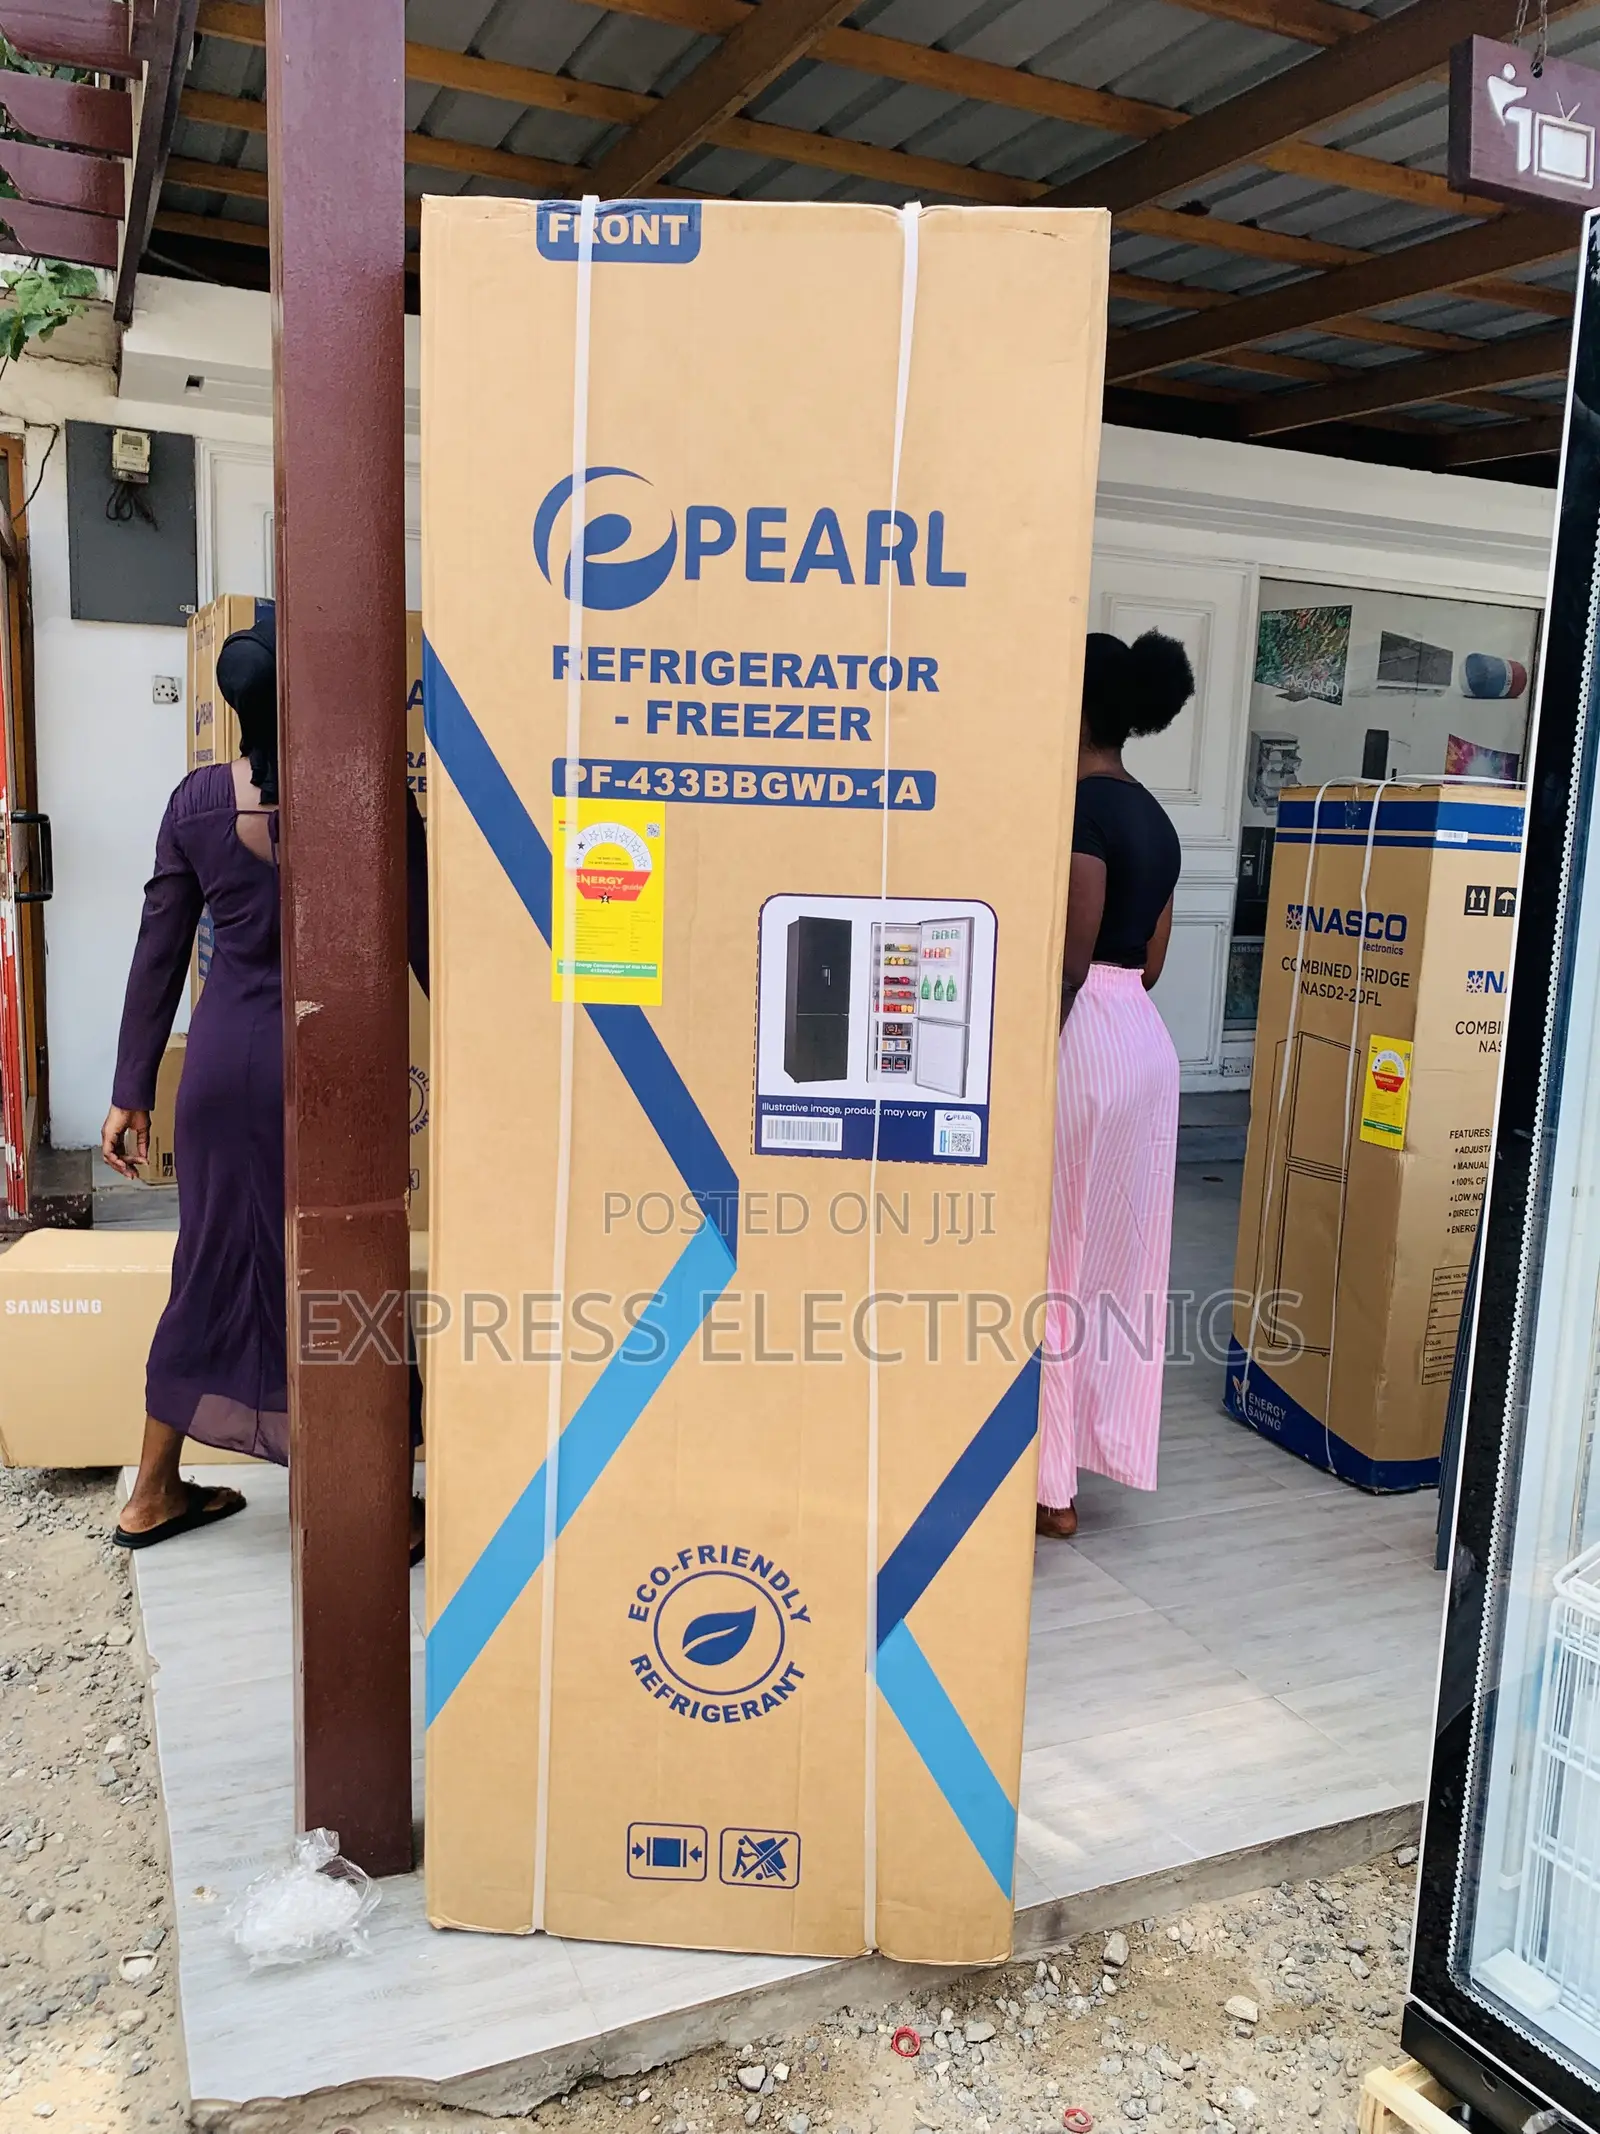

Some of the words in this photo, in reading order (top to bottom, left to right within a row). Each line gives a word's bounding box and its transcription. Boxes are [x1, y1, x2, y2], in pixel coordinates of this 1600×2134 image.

[549, 213, 689, 246] FRONT
[684, 504, 967, 588] PEARL
[552, 644, 940, 692] REFRIGERATOR
[646, 699, 872, 742] FREEZER
[565, 764, 922, 804] PF-433BBGWD-1A
[1304, 905, 1407, 942] NASCO
[1362, 941, 1404, 956] lectronics
[1281, 956, 1352, 980] COMBINED
[1356, 966, 1410, 988] FRIDGE
[1300, 980, 1382, 1007] NASD2-20FL
[1455, 1020, 1504, 1035] COMBI
[1478, 1040, 1502, 1053] NAS
[762, 1102, 808, 1113] Illustrative
[811, 1103, 842, 1116] image,
[844, 1105, 881, 1117] produc
[884, 1107, 904, 1118] may
[906, 1109, 927, 1120] vary
[1449, 1128, 1493, 1139] FEATURES:
[1457, 1161, 1488, 1170] MANUAL
[1456, 1177, 1474, 1186] 100%
[1454, 1193, 1471, 1202] LOW
[1472, 1192, 1484, 1201] NO
[1452, 1208, 1479, 1218] DIRECT
[1451, 1224, 1477, 1234] ENERG
[5, 1298, 102, 1315] SAMSUNG
[1247, 1405, 1282, 1431] SAVING
[1248, 1392, 1287, 1420] ENERGY
[627, 1544, 812, 1624] ECO-FRIENDLY
[629, 1653, 806, 1724] REFRIGERANT
